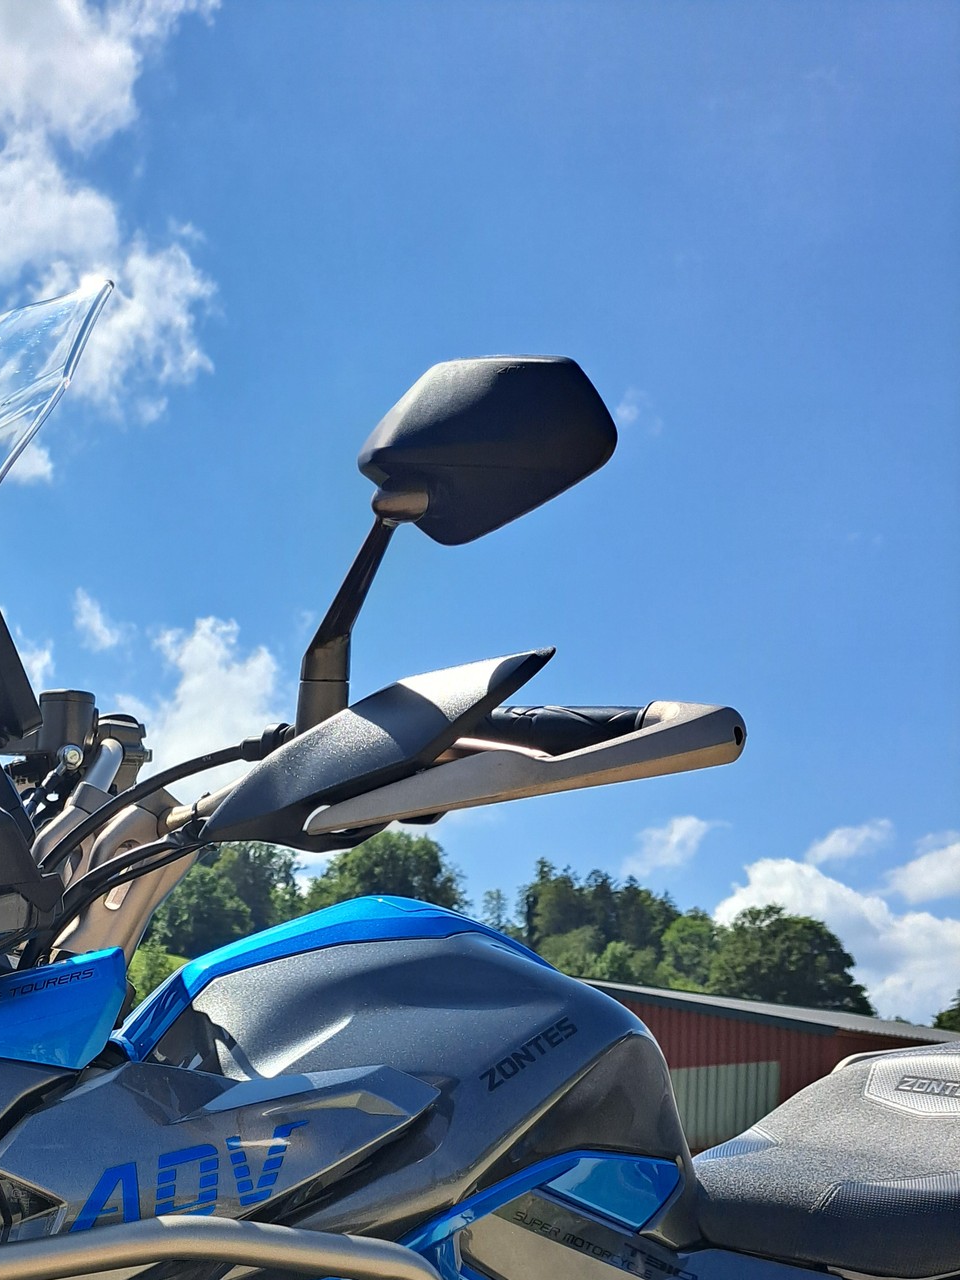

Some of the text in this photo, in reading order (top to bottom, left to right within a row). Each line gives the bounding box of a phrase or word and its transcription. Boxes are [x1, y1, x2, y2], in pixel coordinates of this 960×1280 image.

[9, 968, 96, 997] TOURERS
[478, 1015, 578, 1092] ZONTES
[68, 1119, 310, 1233] ADV
[512, 1211, 655, 1280] SUPER MOTORCYCLE
